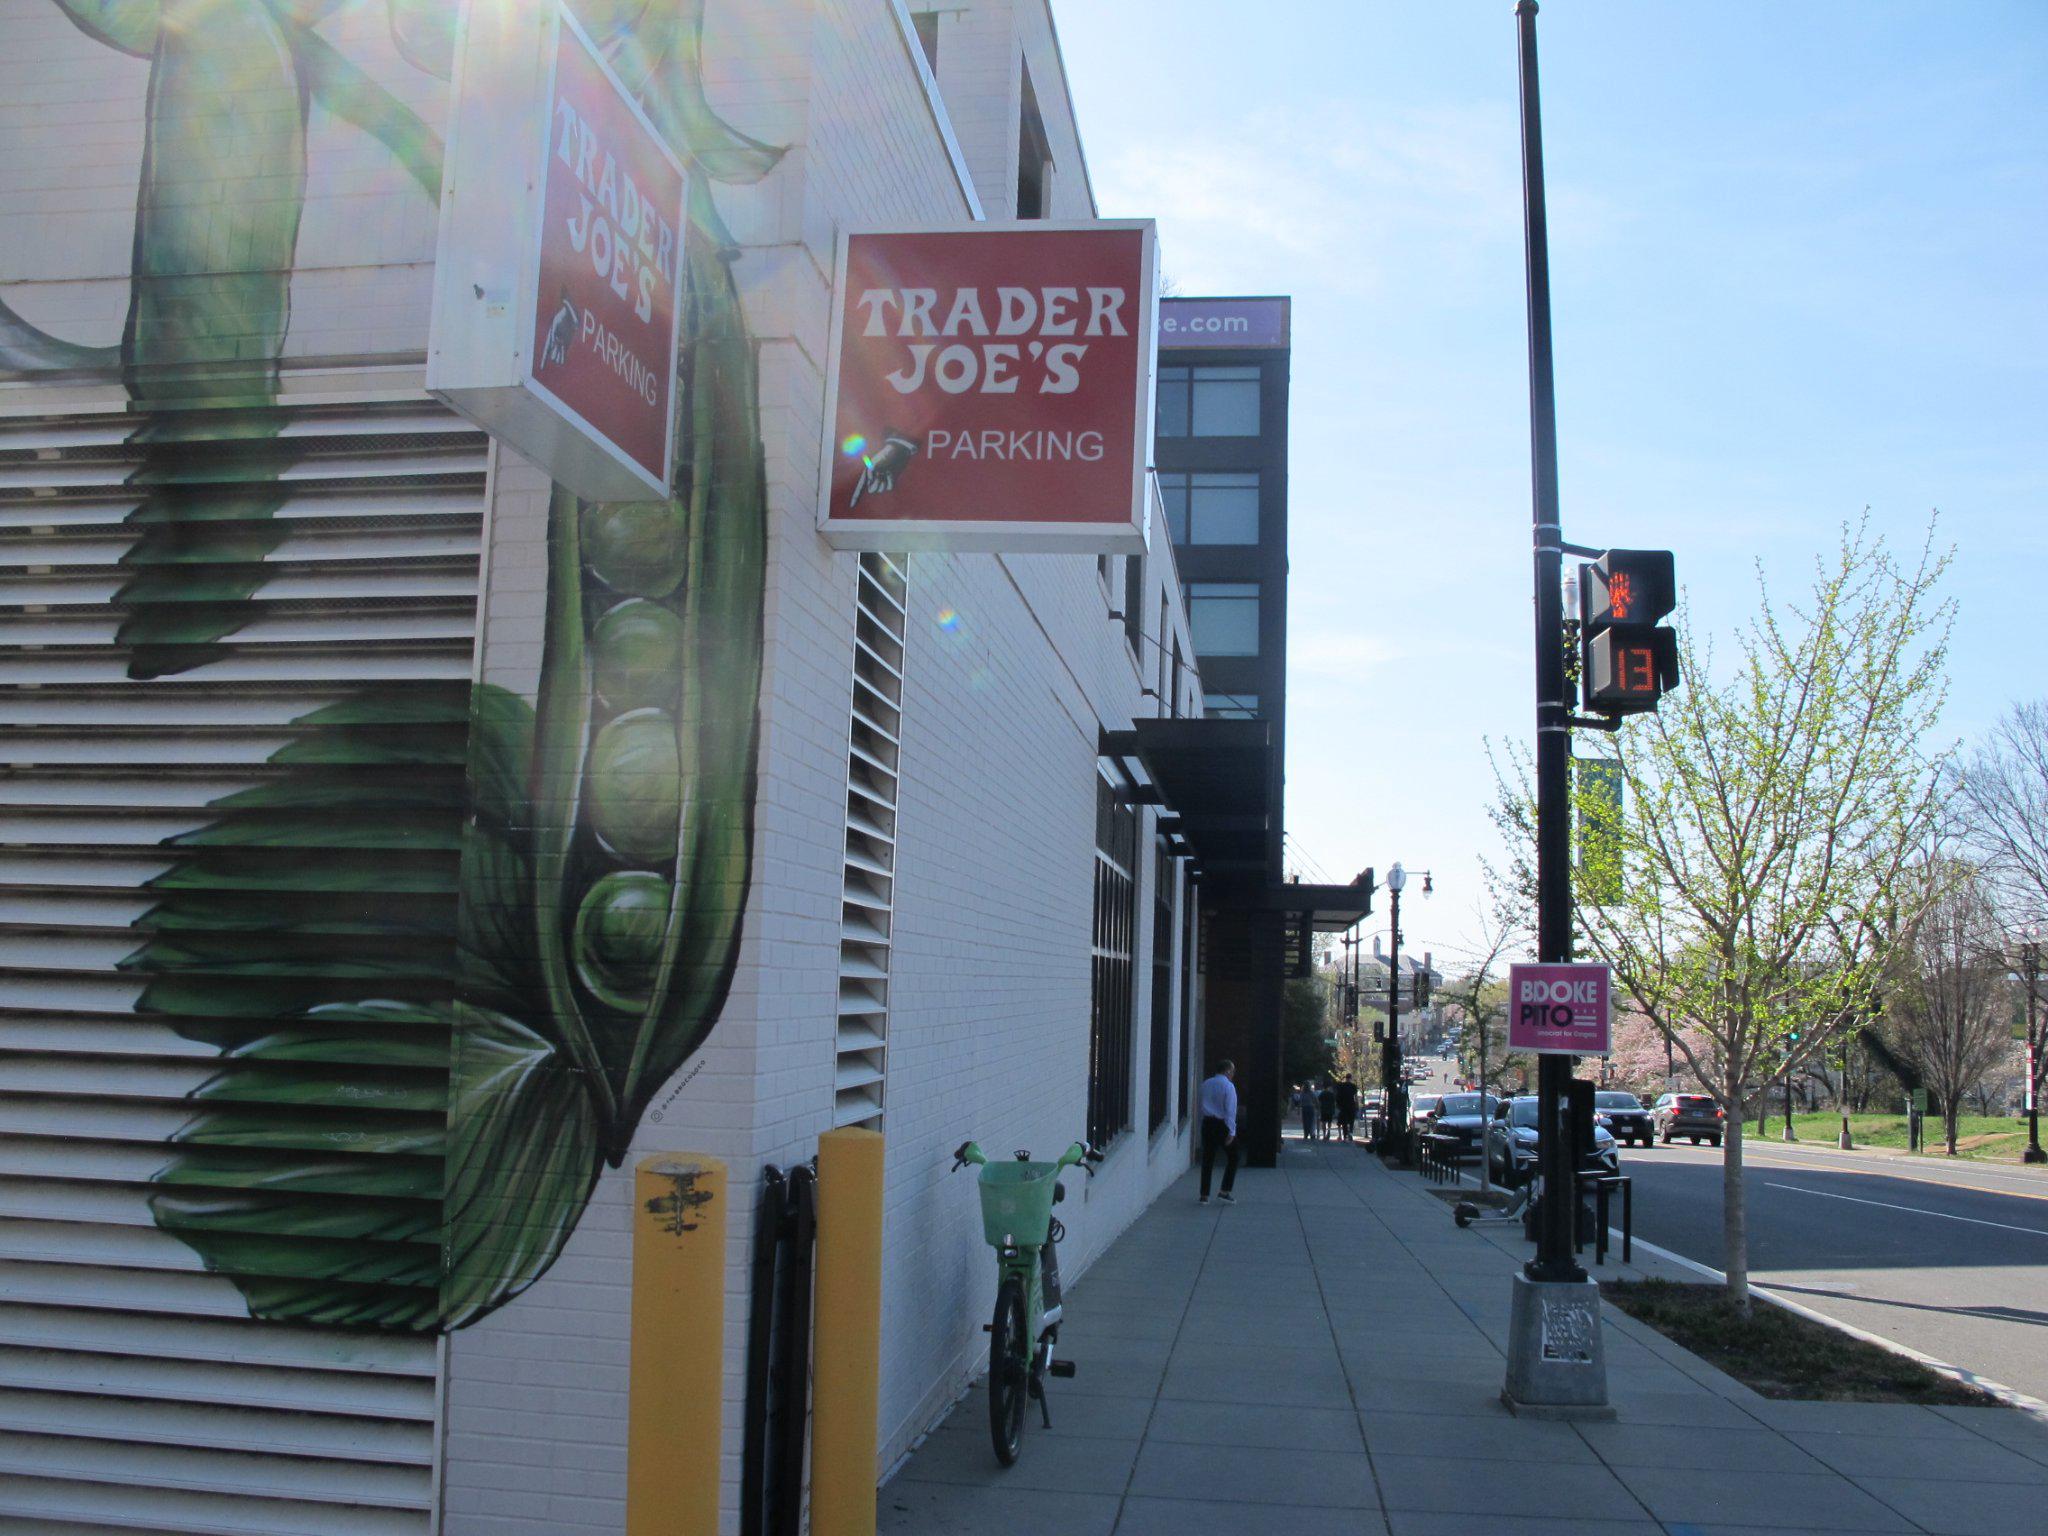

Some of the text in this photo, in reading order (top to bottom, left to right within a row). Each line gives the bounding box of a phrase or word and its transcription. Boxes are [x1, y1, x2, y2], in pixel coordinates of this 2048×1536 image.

[556, 96, 672, 283] TRADER
[567, 193, 655, 324] JOE'S
[857, 286, 1128, 336] TRADER
[1158, 316, 1248, 332] e.com
[582, 308, 656, 406] PARKING
[886, 341, 1088, 394] JOE'S
[927, 430, 1104, 461] PARKING
[1618, 648, 1653, 691] 13
